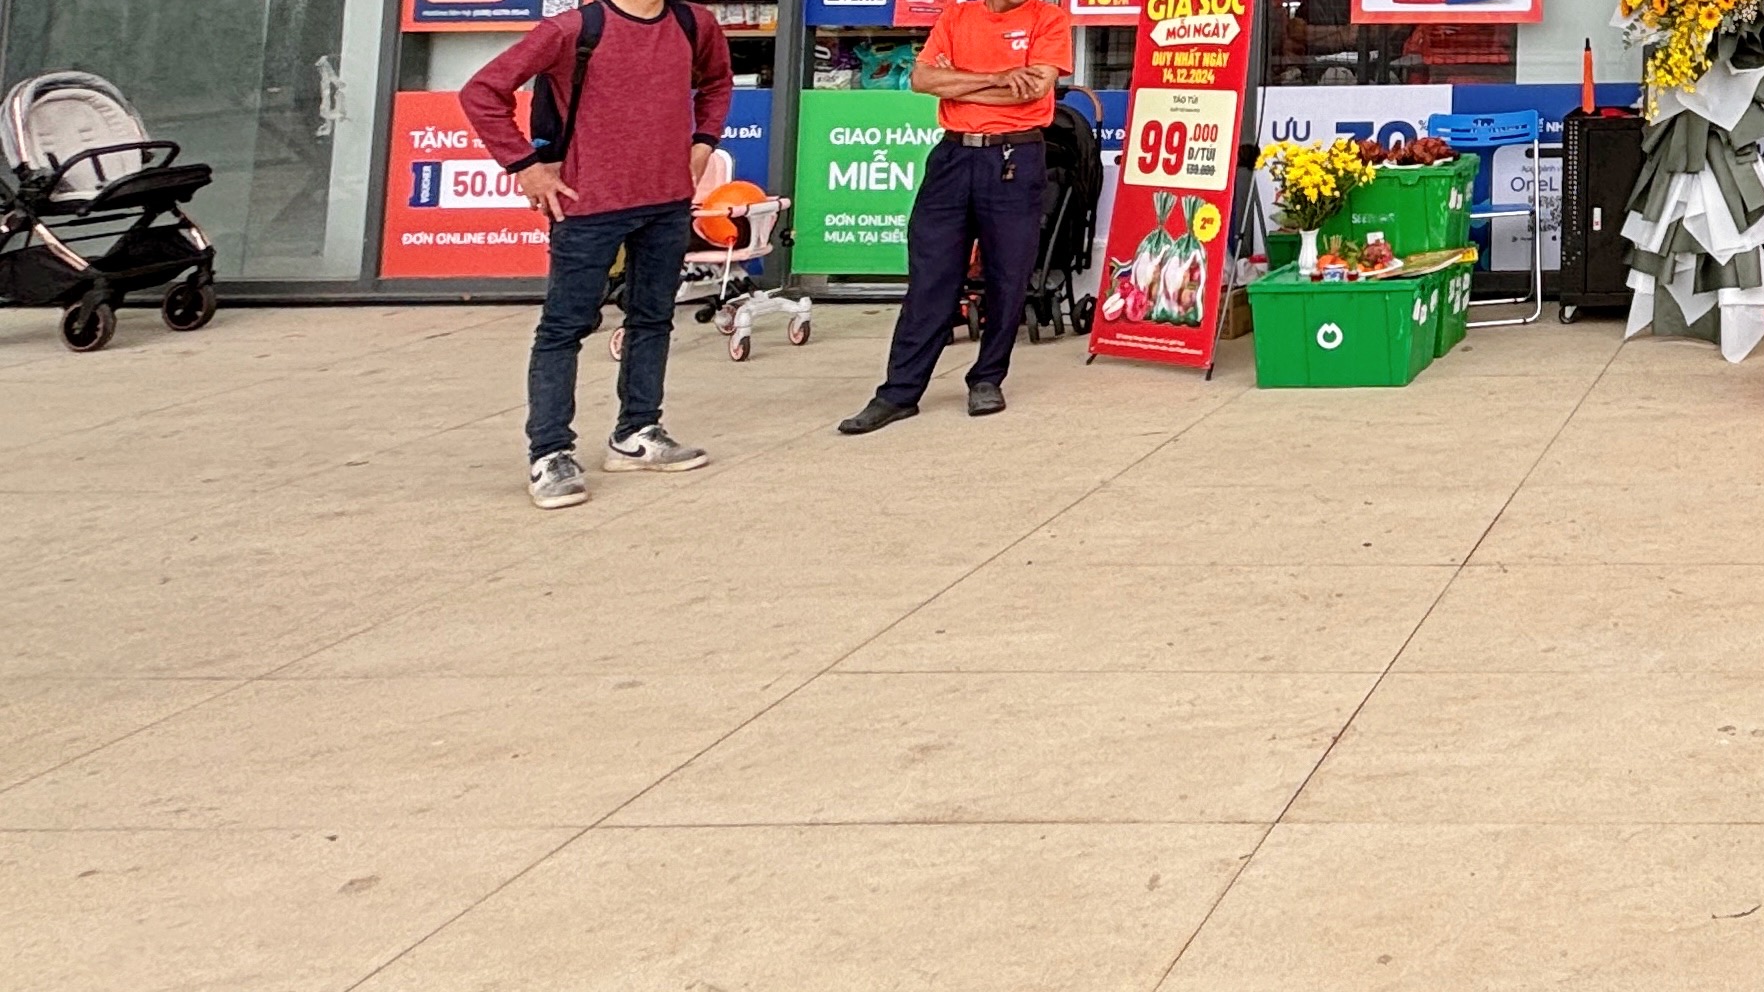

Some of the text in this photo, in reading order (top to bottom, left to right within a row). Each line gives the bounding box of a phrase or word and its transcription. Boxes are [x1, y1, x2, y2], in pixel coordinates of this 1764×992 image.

[1166, 18, 1230, 40] MỖI NGÀY
[1152, 47, 1229, 67] DUY NHẤT NGÀY
[1162, 68, 1215, 84] 14.12.2024
[739, 123, 762, 139] ĐÃI
[829, 122, 946, 145] GIAO HÀNG
[1272, 117, 1311, 142] ƯU
[409, 126, 468, 154] TẶNG
[828, 149, 914, 191] MIỄN
[825, 213, 907, 226] ĐƠN ONLINE
[401, 231, 434, 245] ĐƠN
[436, 233, 486, 245] ONLINE
[487, 228, 518, 244] ĐẦU
[824, 231, 855, 243] MUA
[857, 231, 878, 246] TẠI
